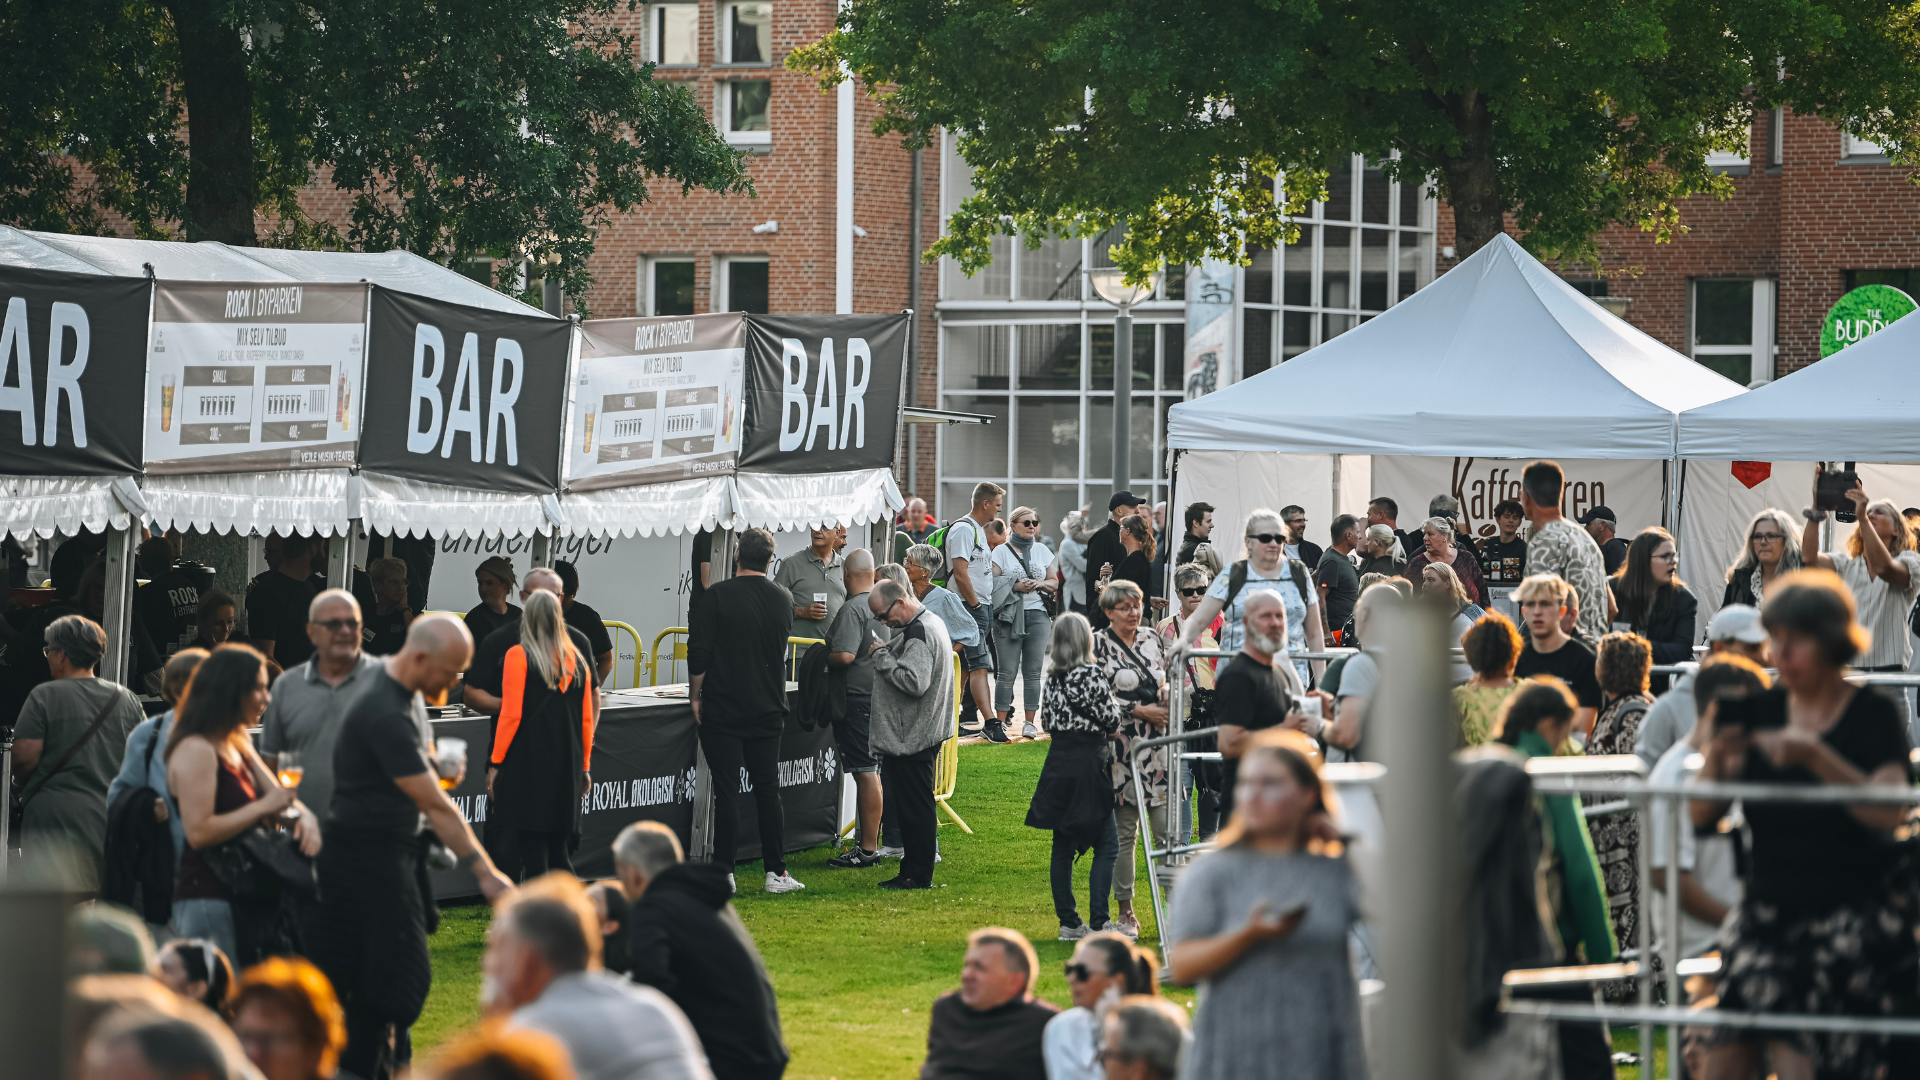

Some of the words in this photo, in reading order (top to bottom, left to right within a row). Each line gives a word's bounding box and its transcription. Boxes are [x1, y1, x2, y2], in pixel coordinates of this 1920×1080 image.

[225, 289, 250, 318] ROCK
[251, 289, 256, 316] I
[257, 286, 303, 316] BYPARKEN
[1867, 309, 1882, 320] THE
[237, 328, 248, 346] MIX
[249, 328, 265, 346] SELV
[266, 327, 287, 346] TILBUD
[635, 325, 655, 351] ROCK
[655, 325, 660, 348] I
[659, 319, 695, 348] BYPARKEN
[1835, 319, 1889, 342] BUDD
[0, 297, 90, 448] AR
[212, 369, 227, 383] SMALL
[291, 368, 305, 382] LARGE
[406, 322, 524, 467] BAR
[778, 337, 872, 452] BAR
[301, 452, 317, 463] VEJLE
[692, 462, 705, 473] VEJLE
[1451, 457, 1605, 534] Kafferen
[167, 586, 199, 607] ROCK
[178, 604, 198, 616] BYPAR
[777, 756, 814, 788] KOLOGISK
[592, 781, 629, 811] ROYAL
[630, 775, 675, 808] ØKOLOGISK
